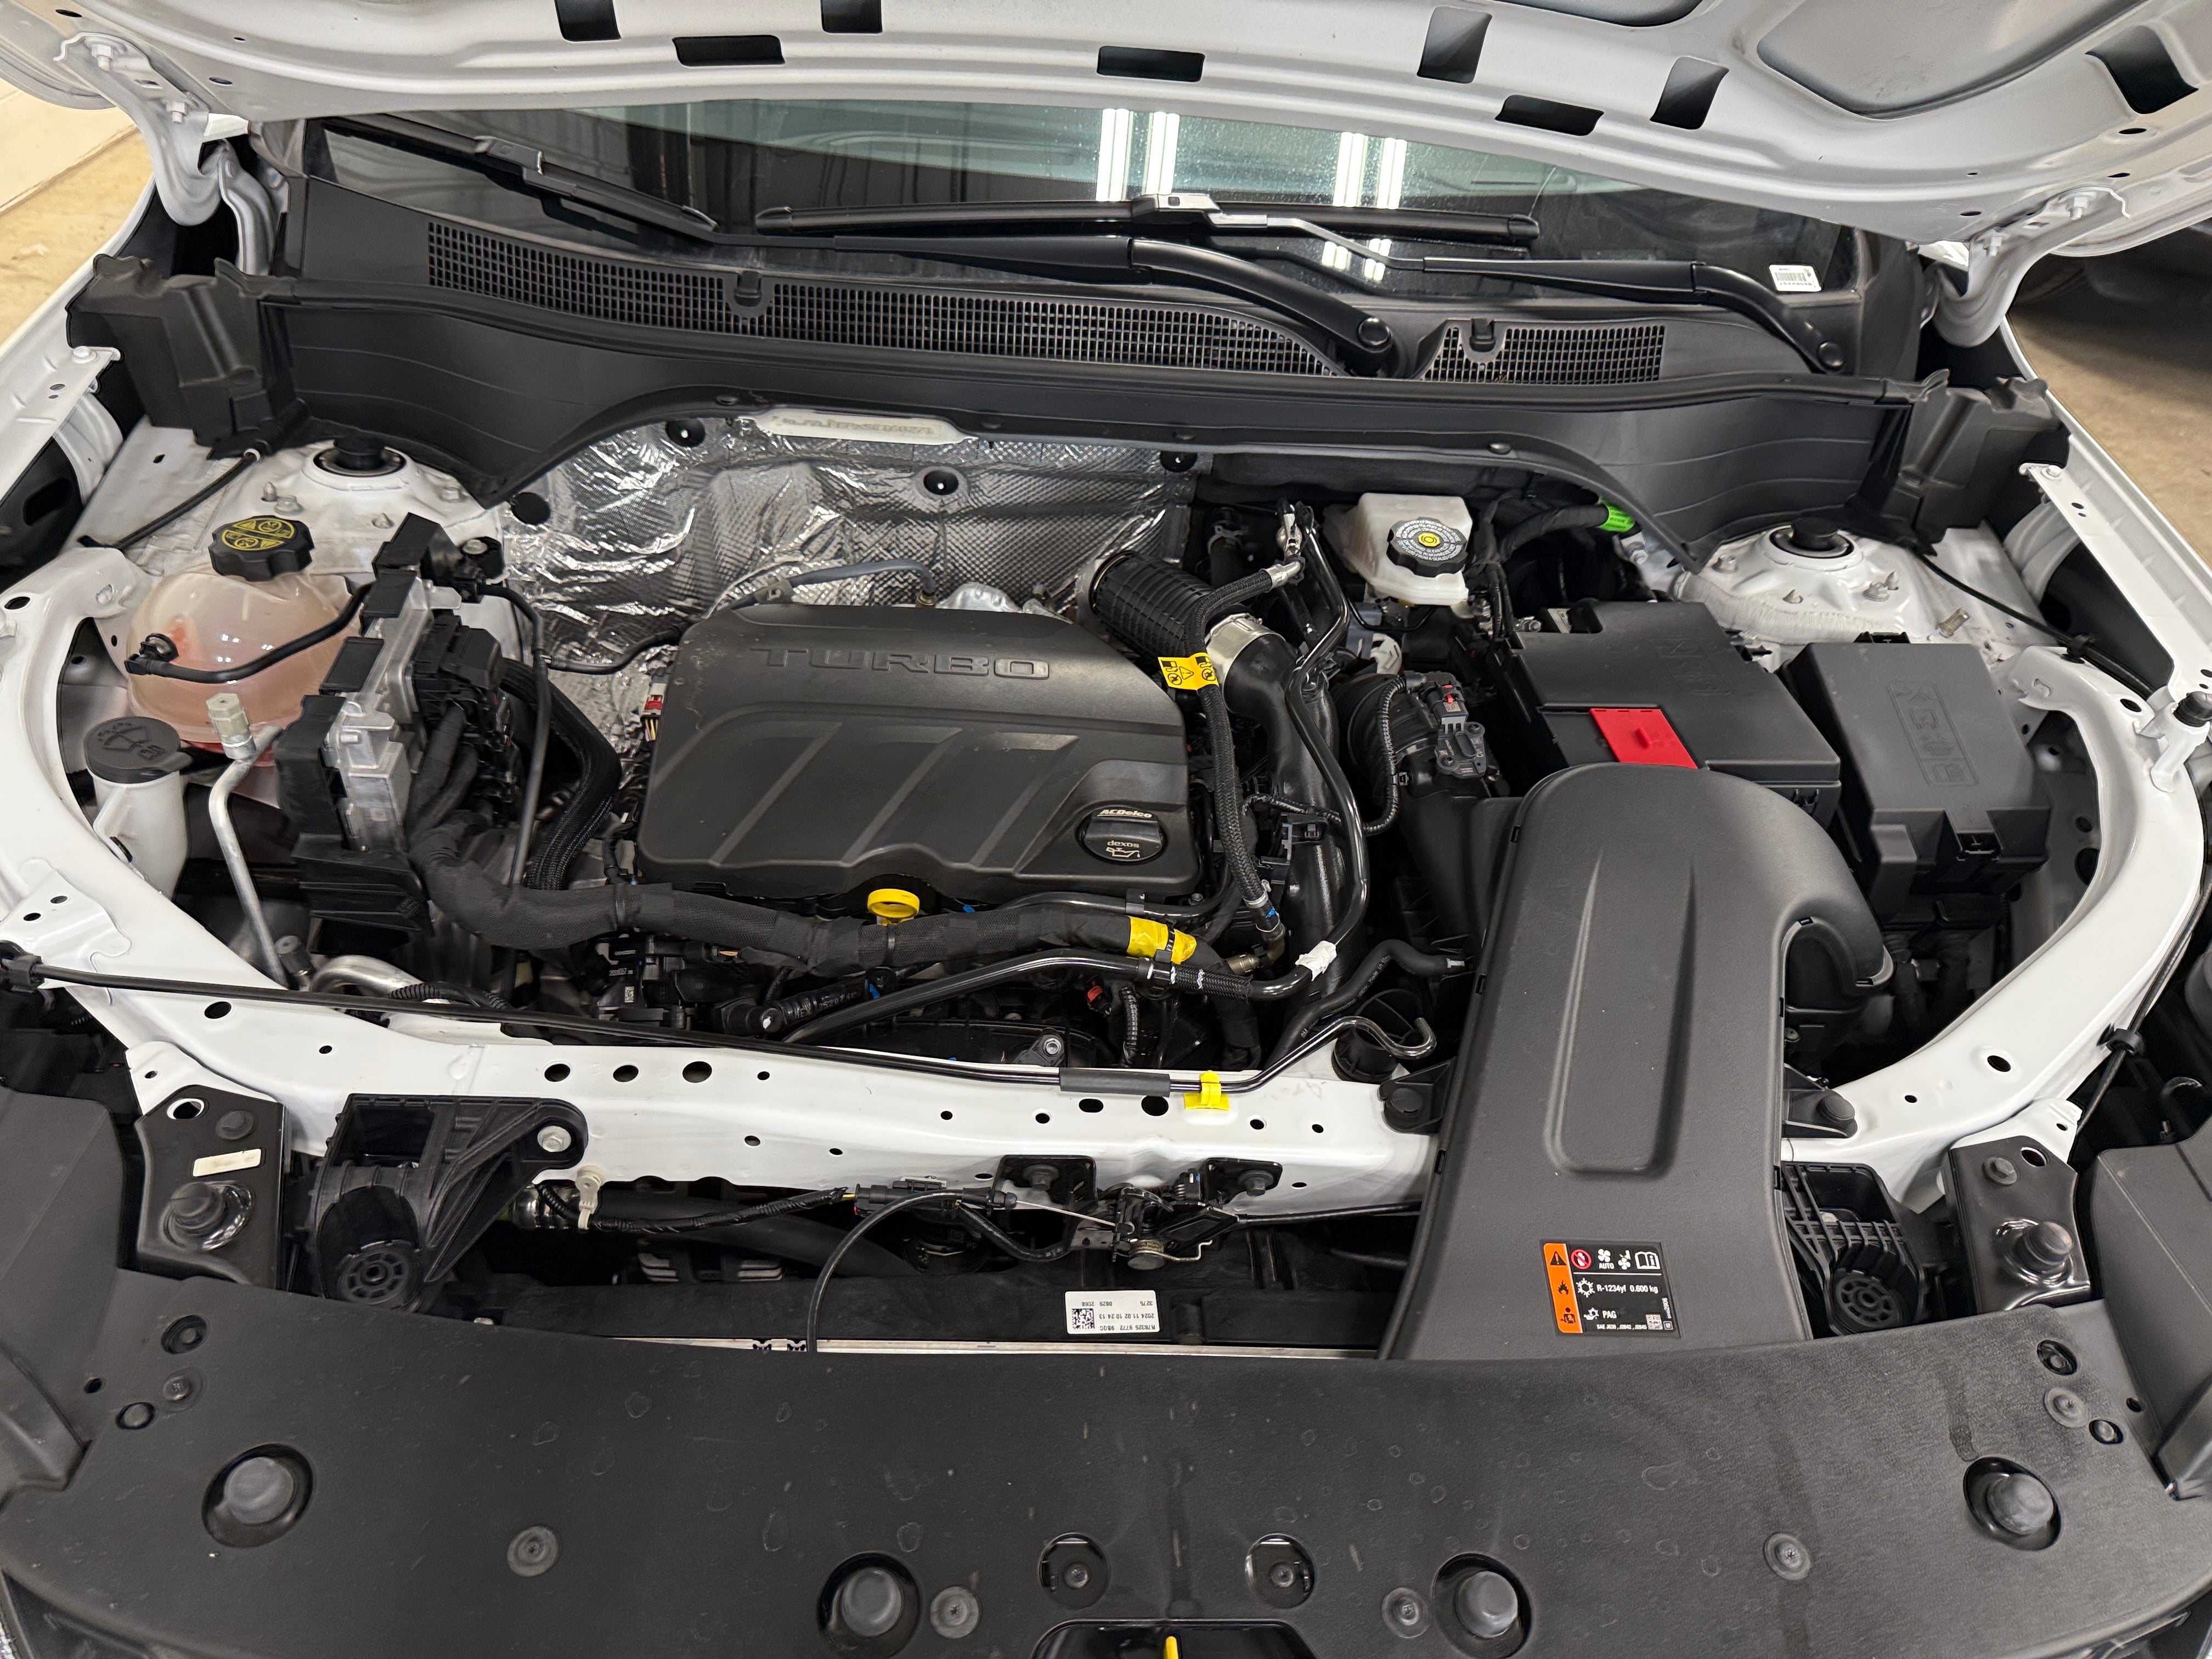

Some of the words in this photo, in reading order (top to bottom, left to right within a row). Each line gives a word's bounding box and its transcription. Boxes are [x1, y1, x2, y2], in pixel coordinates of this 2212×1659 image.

[750, 647, 1050, 680] TURBO
[1098, 809, 1152, 818] ACDelco
[1107, 840, 1140, 848] dexos
[1596, 1284, 1627, 1293] R-1234yf
[1649, 1285, 1658, 1294] kg
[1602, 1311, 1617, 1319] PAG
